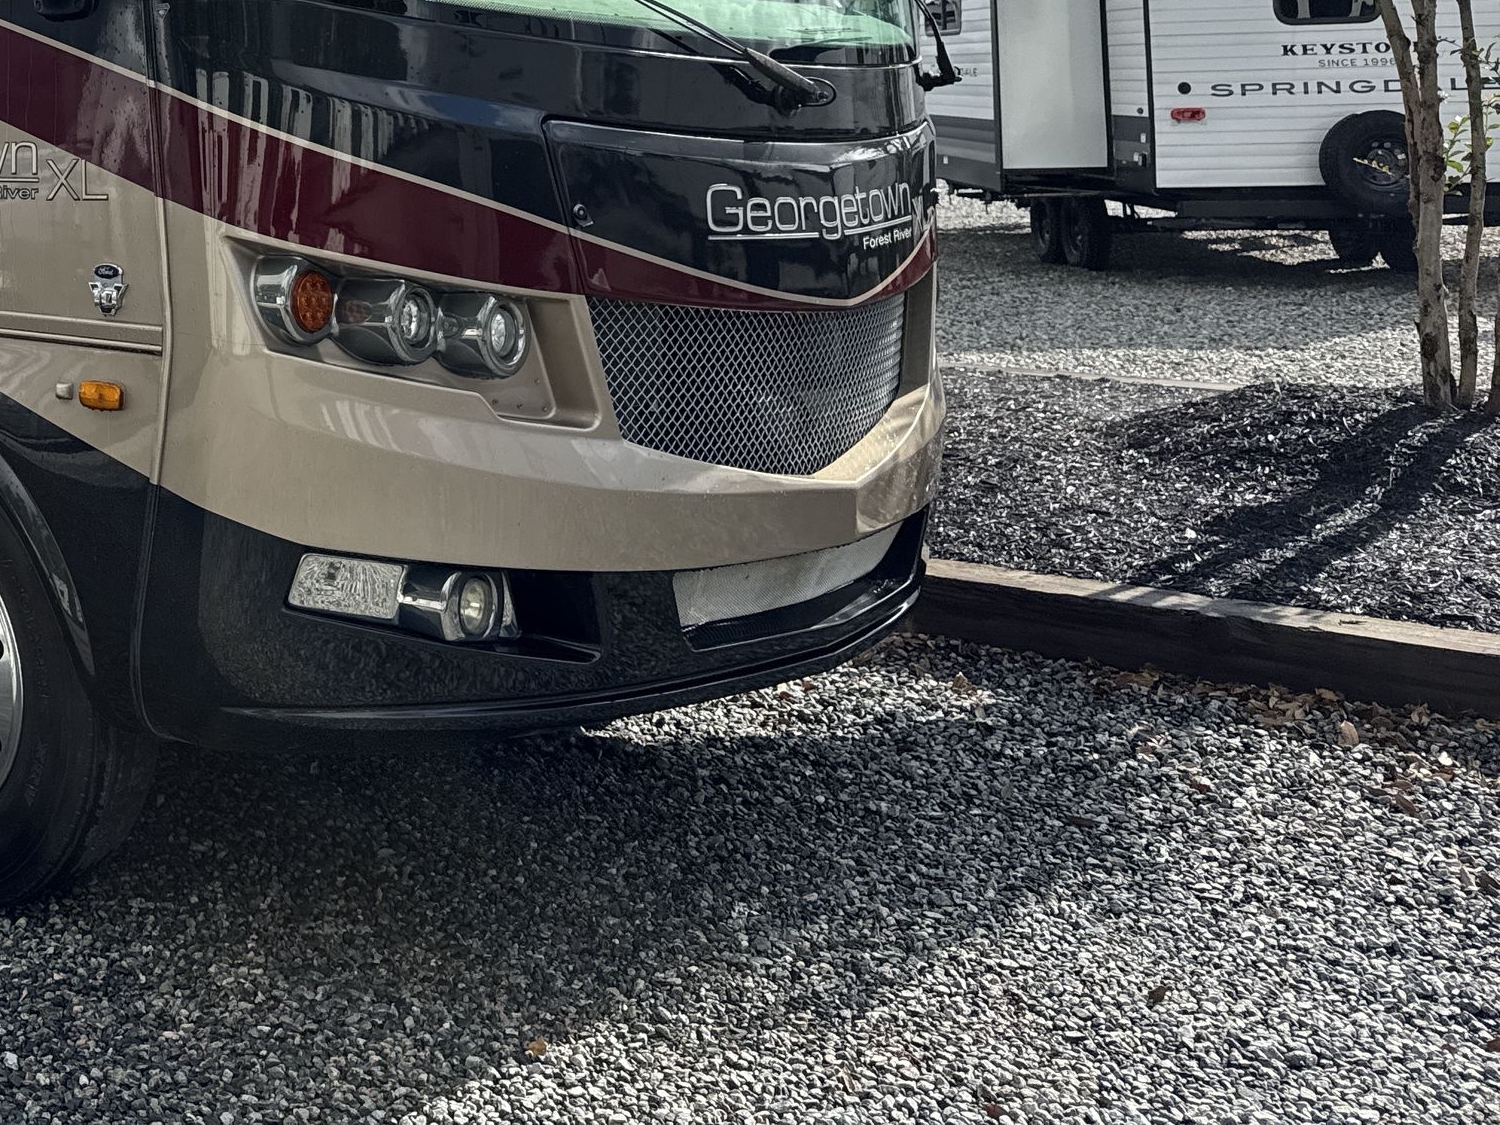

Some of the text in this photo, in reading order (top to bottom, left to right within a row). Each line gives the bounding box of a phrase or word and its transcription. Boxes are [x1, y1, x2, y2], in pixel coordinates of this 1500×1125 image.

[1281, 41, 1419, 57] KEYSTO
[1318, 57, 1358, 67] SINCE
[1210, 77, 1500, 97] SPRINGDLE
[46, 159, 109, 201] XL
[706, 181, 912, 240] Georgetown
[862, 227, 913, 250] Forest River
